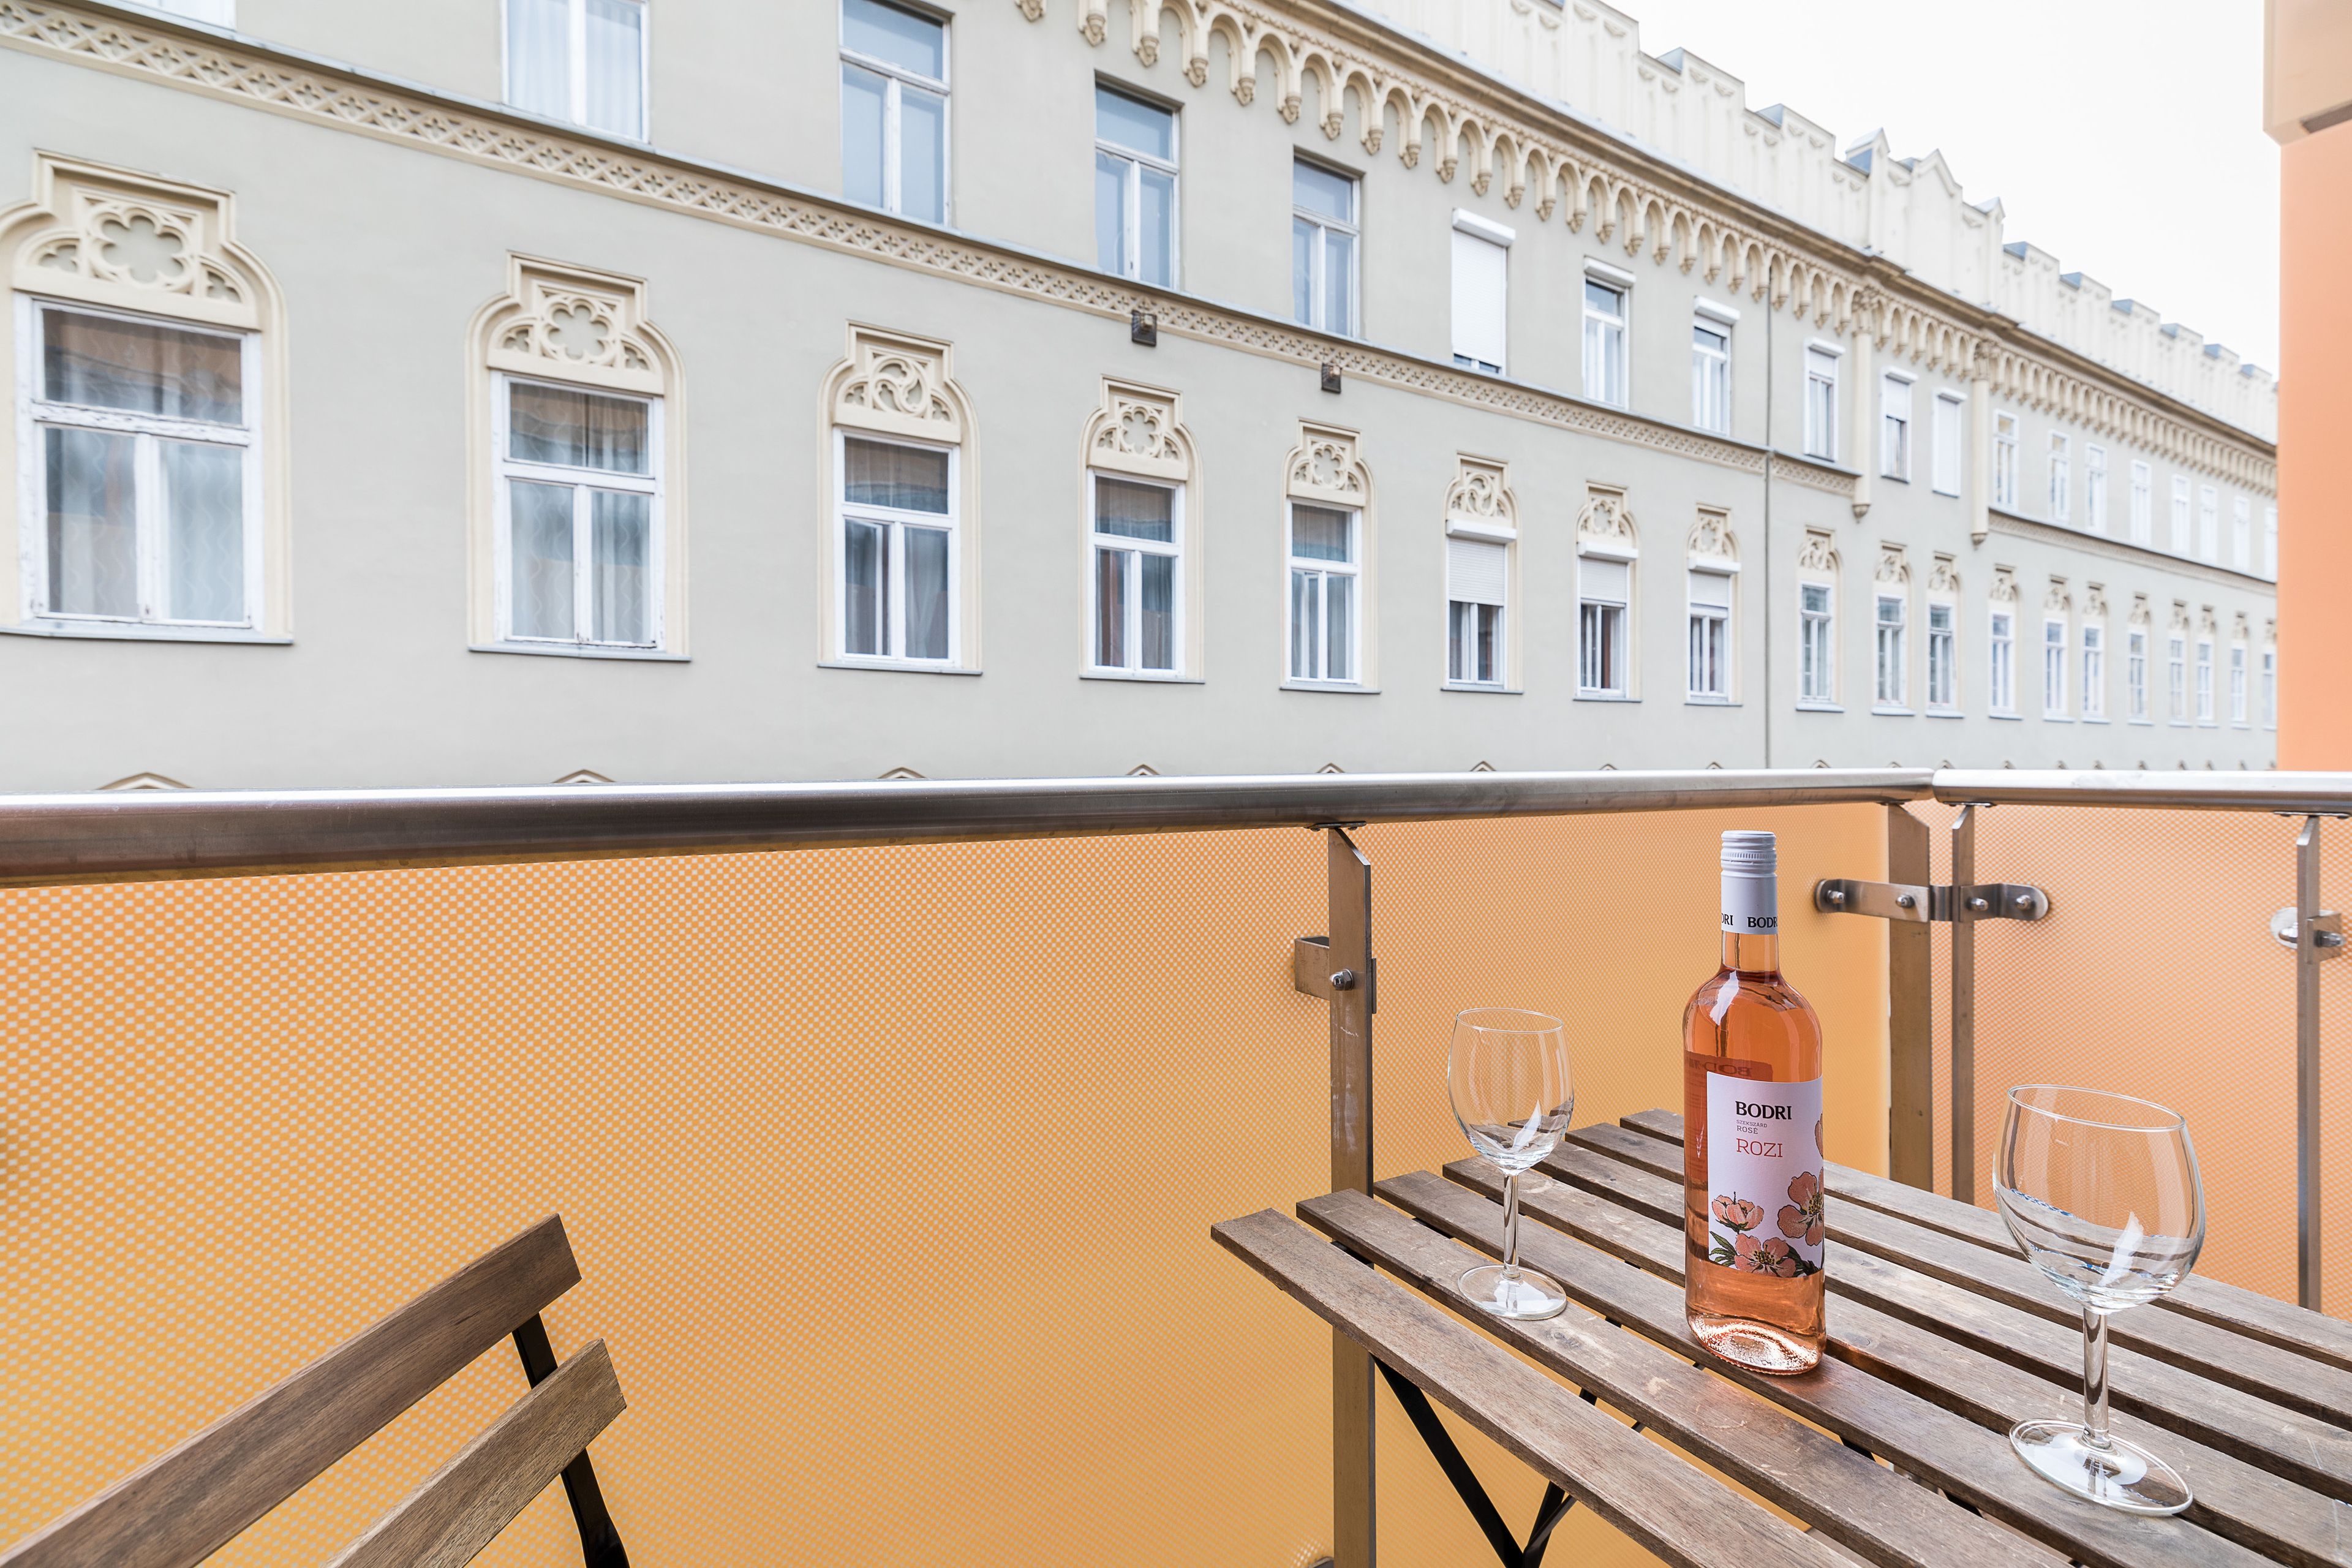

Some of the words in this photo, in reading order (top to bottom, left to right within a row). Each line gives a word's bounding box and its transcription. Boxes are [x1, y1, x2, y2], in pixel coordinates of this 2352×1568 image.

[1735, 1101, 1792, 1120] BODRI
[1736, 1125, 1758, 1134] ROSÉ
[1736, 1137, 1783, 1158] ROZI
